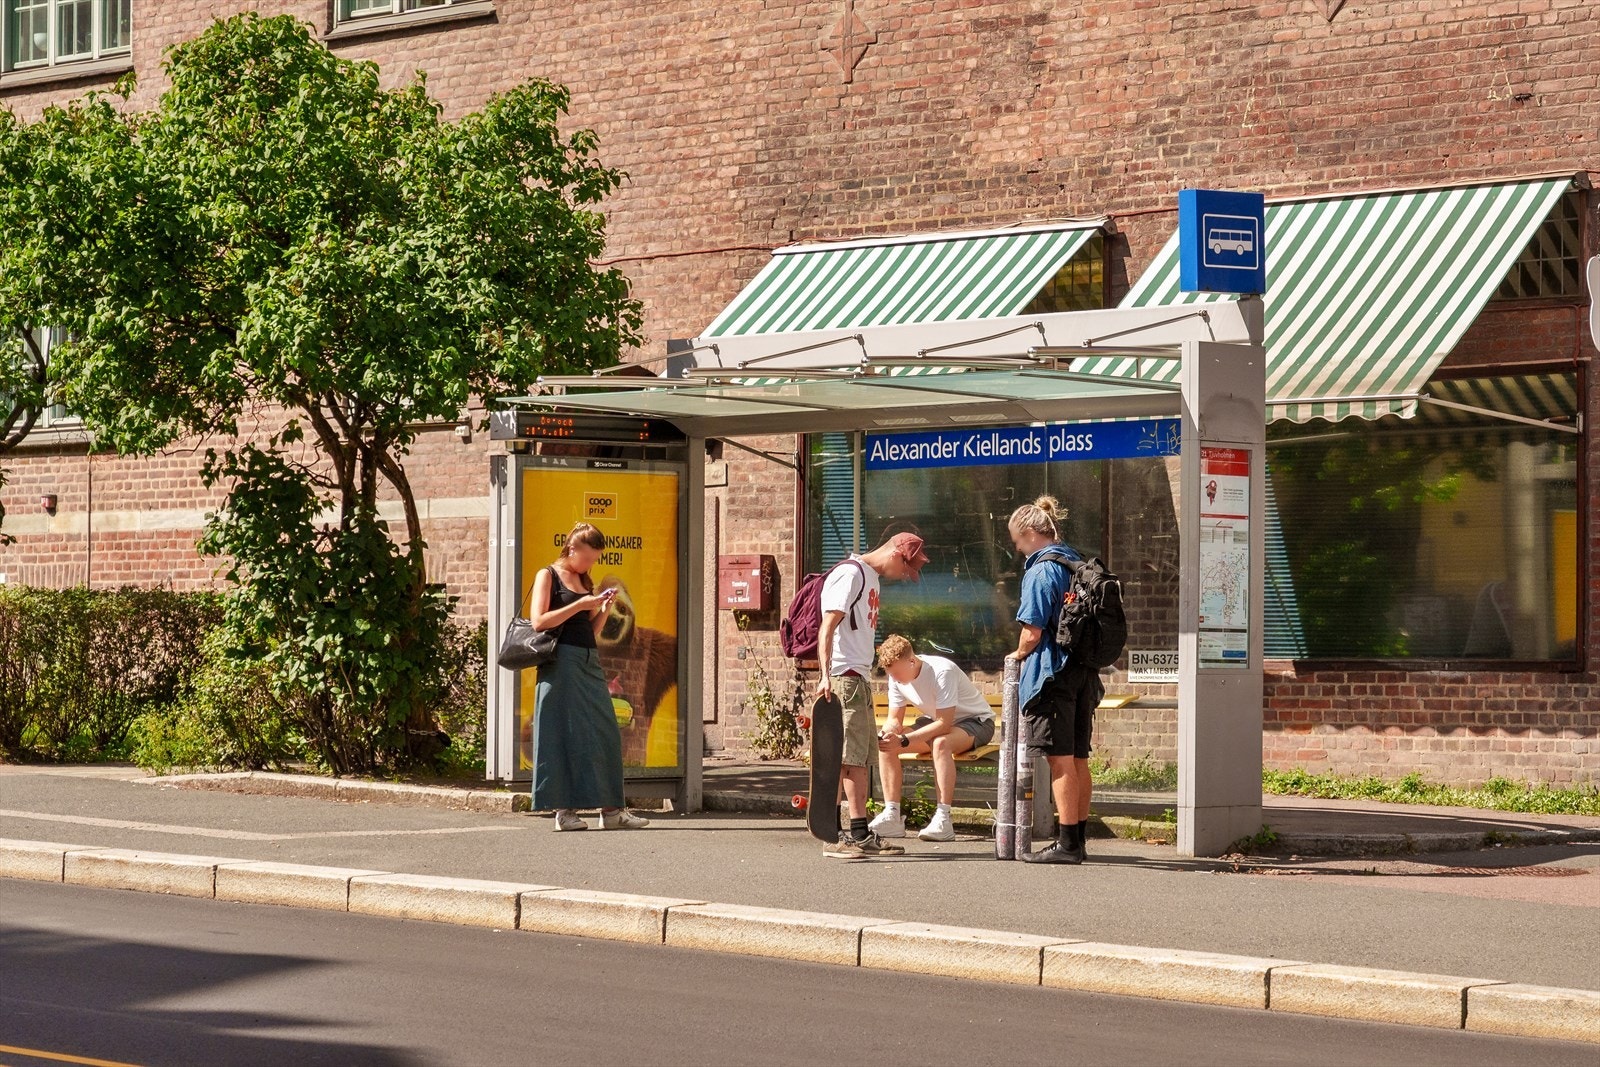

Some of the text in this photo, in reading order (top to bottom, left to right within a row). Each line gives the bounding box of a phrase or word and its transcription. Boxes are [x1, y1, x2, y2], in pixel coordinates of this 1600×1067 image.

[870, 428, 1093, 462] Alexander Kiellands plass
[589, 498, 612, 507] coop
[589, 506, 605, 515] prix
[554, 533, 643, 550] GR NNSAKER
[597, 553, 623, 566] MER!
[1132, 653, 1179, 665] BN-6375
